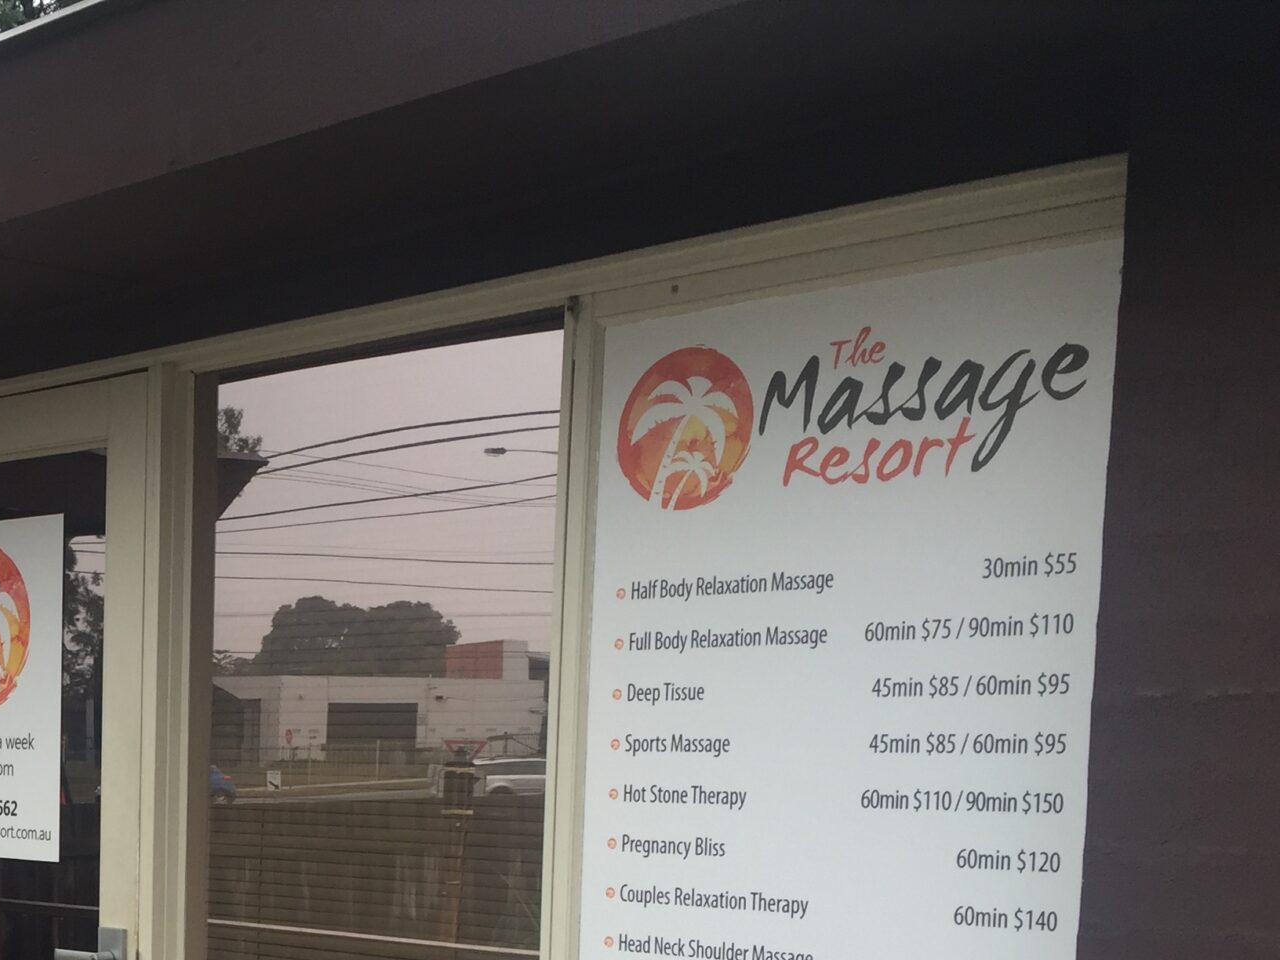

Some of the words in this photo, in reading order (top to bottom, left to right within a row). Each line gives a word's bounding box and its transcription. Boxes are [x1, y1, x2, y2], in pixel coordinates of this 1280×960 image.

[829, 326, 888, 372] The
[759, 341, 1089, 475] Massage
[783, 415, 978, 487] Resort
[982, 556, 1038, 579] 30min
[1044, 552, 1077, 577] $55
[631, 580, 658, 600] Half
[660, 578, 693, 602] Body
[696, 575, 767, 596] Relaxation
[771, 572, 834, 594] Massage
[629, 632, 651, 651] Full
[655, 631, 688, 654] Body
[691, 629, 761, 648] Relaxation
[765, 626, 827, 649] Massage
[865, 621, 916, 642] 60min
[922, 620, 951, 642] $75
[969, 616, 1023, 638] 90min
[1030, 613, 1074, 638] $110
[627, 683, 660, 706] Deep
[664, 682, 704, 701] Tissue
[872, 677, 923, 697] 45min
[929, 675, 959, 699] $85
[976, 675, 1031, 696] 60min
[1037, 673, 1070, 697] $95
[6, 733, 34, 750] week
[625, 734, 667, 757] Sports
[671, 734, 730, 758] Massage
[869, 734, 920, 754] 45min
[926, 733, 956, 756] $85
[973, 733, 1028, 754] 60min
[1034, 732, 1067, 756] $95
[624, 784, 646, 803] Hot
[650, 785, 688, 804] Stone
[691, 785, 746, 810] Therapy
[861, 789, 909, 810] 60min
[913, 789, 952, 812] $110
[966, 791, 1017, 812] 90min
[1022, 790, 1064, 815] $150
[622, 834, 691, 860] Pregnancy
[695, 837, 725, 857] Bliss
[957, 849, 1010, 870] 60min
[1017, 849, 1060, 874] $120
[620, 884, 670, 908] Couples
[674, 887, 746, 910] Relaxation
[750, 892, 808, 919] Therapy
[954, 906, 1008, 928] 60min
[1014, 907, 1057, 932] $140
[619, 933, 651, 954] Head
[654, 937, 685, 957] Neck
